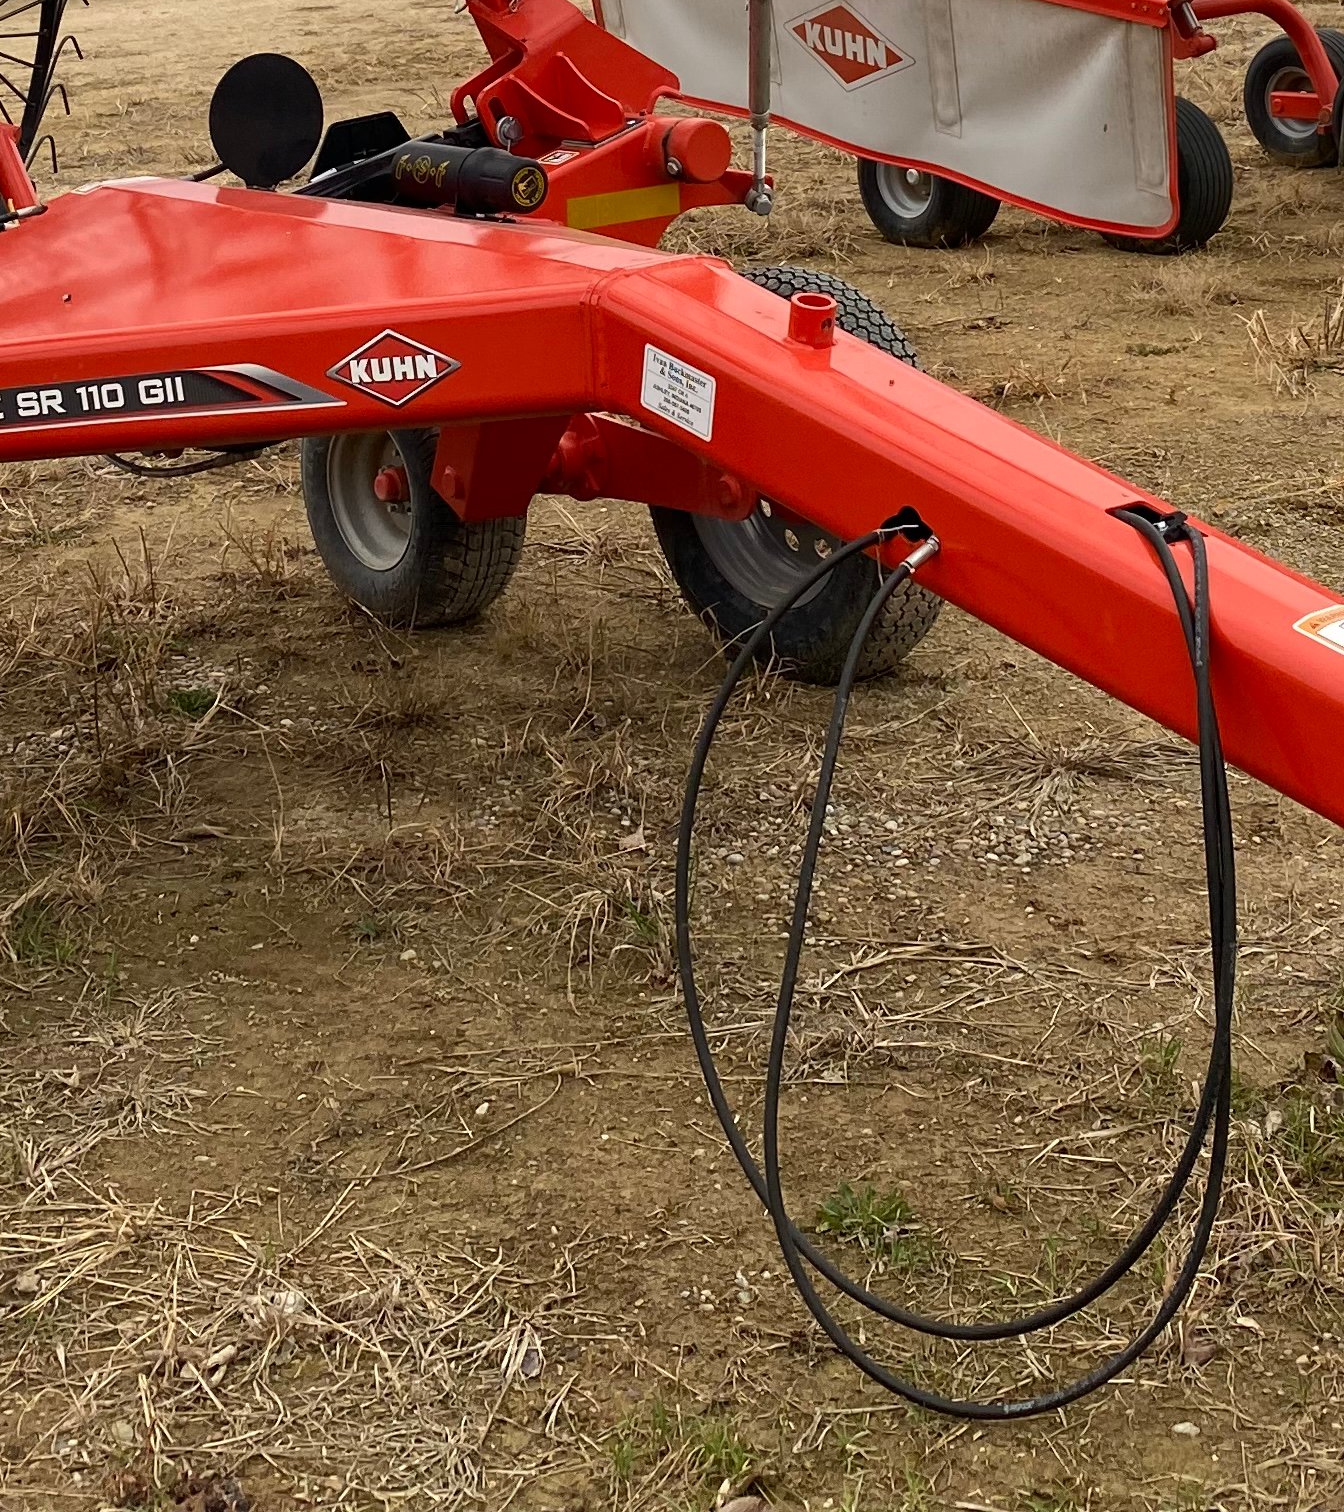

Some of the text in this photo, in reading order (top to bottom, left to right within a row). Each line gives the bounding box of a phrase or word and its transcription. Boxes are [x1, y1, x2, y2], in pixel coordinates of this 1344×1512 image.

[804, 20, 887, 69] KUHN
[349, 354, 438, 384] KUHN
[652, 353, 667, 367] Ivan
[659, 367, 666, 377] &
[17, 390, 67, 417] SR
[76, 383, 125, 412] 110
[138, 376, 185, 406] GII
